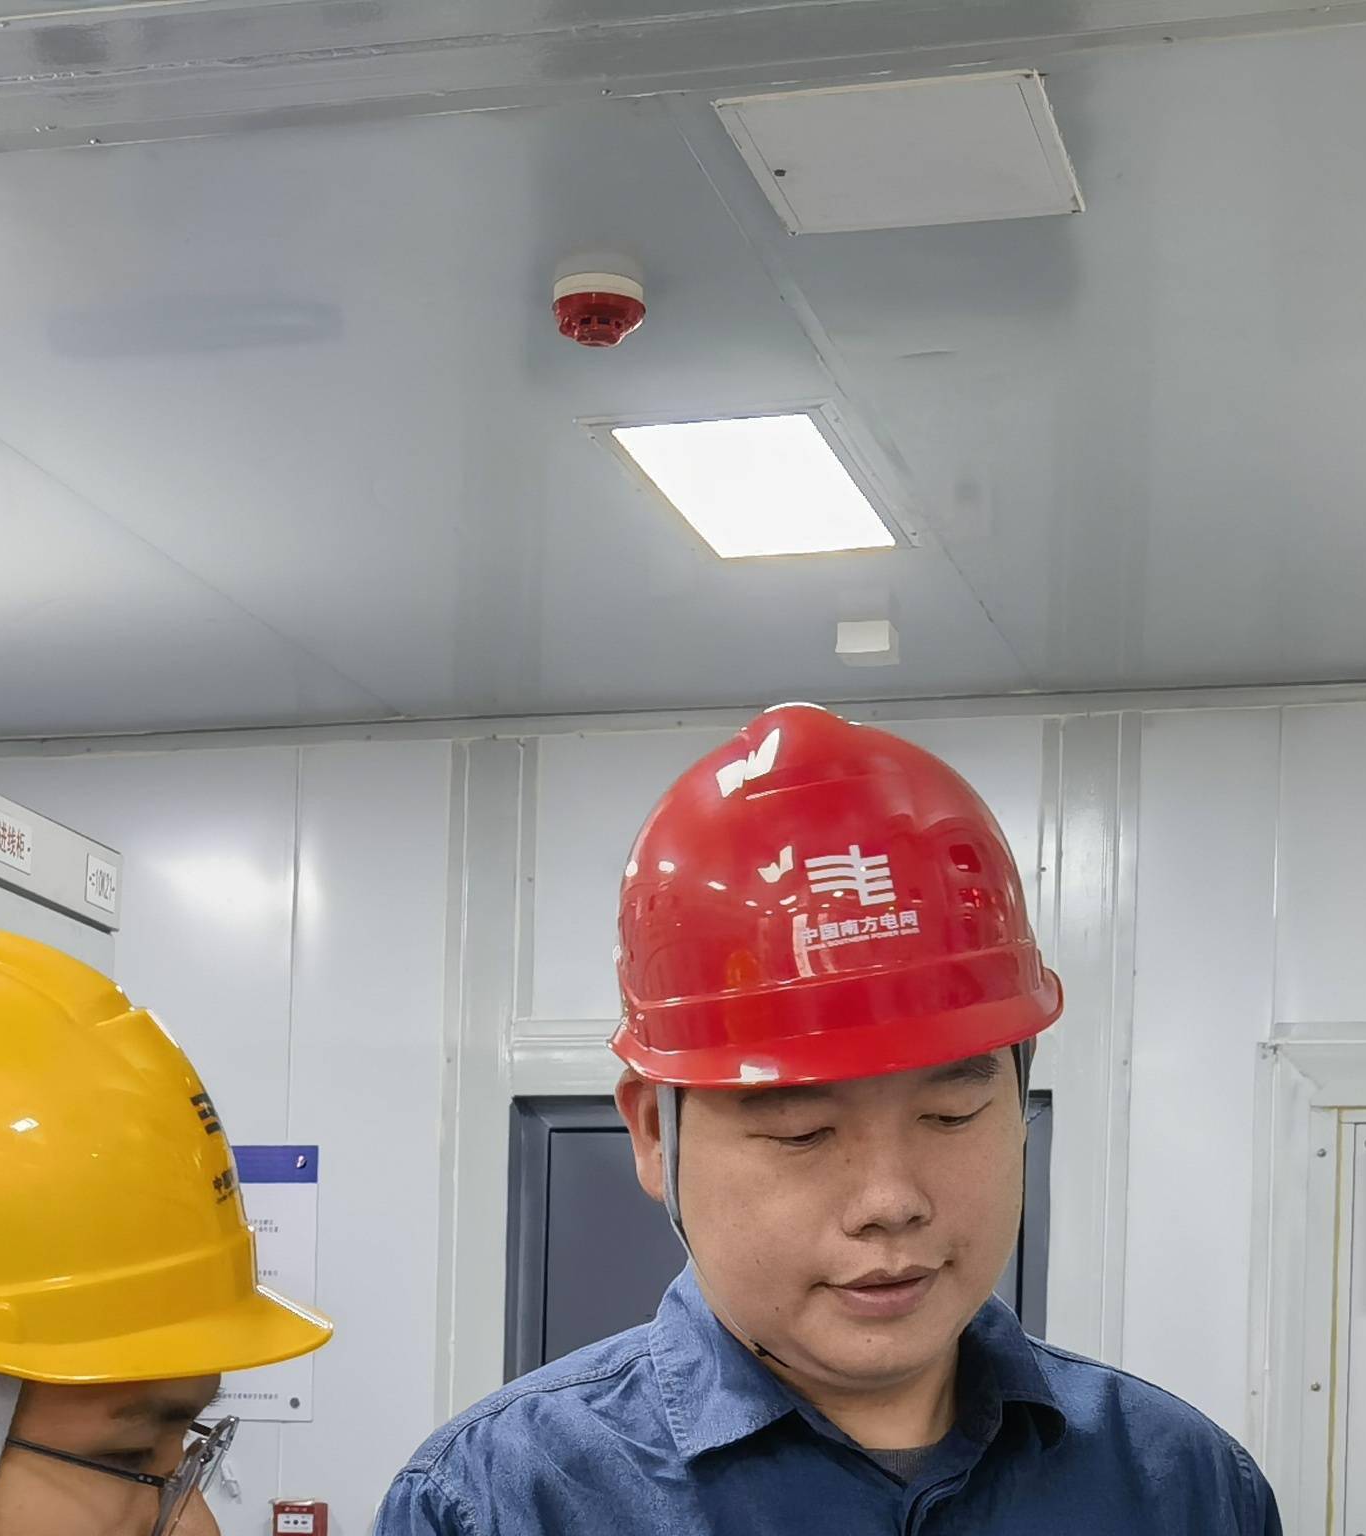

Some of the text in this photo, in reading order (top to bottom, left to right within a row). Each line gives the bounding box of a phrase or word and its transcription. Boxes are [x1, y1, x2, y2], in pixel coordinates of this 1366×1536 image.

[802, 911, 917, 944] 中国南方电网
